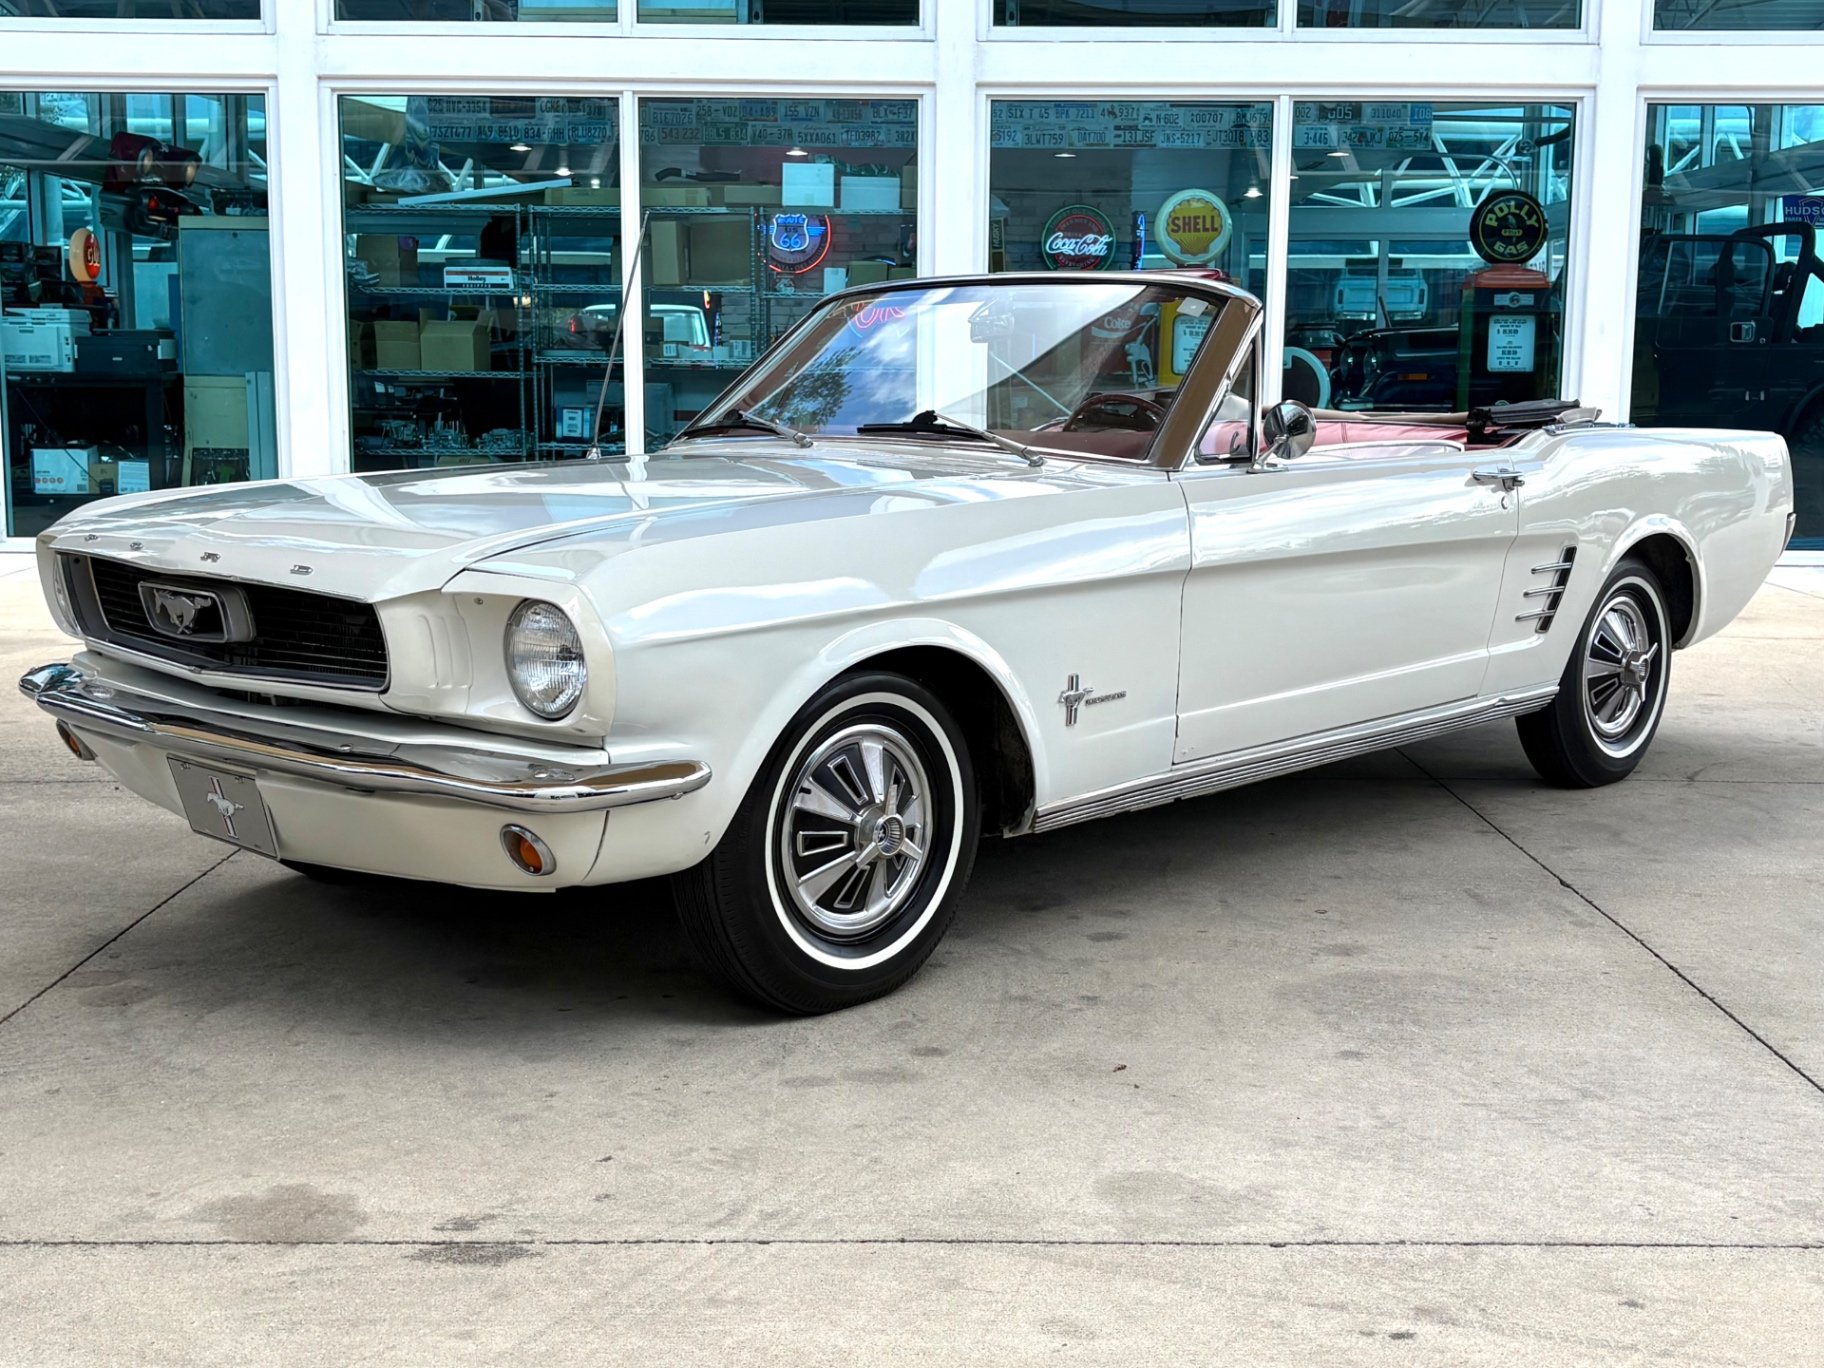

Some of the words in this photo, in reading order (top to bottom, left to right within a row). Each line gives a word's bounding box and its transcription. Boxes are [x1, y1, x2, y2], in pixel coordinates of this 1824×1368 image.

[1008, 108, 1025, 119] SIX
[777, 216, 804, 224] ROUTE
[1485, 200, 1539, 227] POLLY
[1171, 216, 1219, 233] SHELL
[780, 233, 802, 248] 66
[1046, 232, 1113, 256] Coca-Cola
[1493, 241, 1529, 255] GAS
[1104, 317, 1131, 329] Coke
